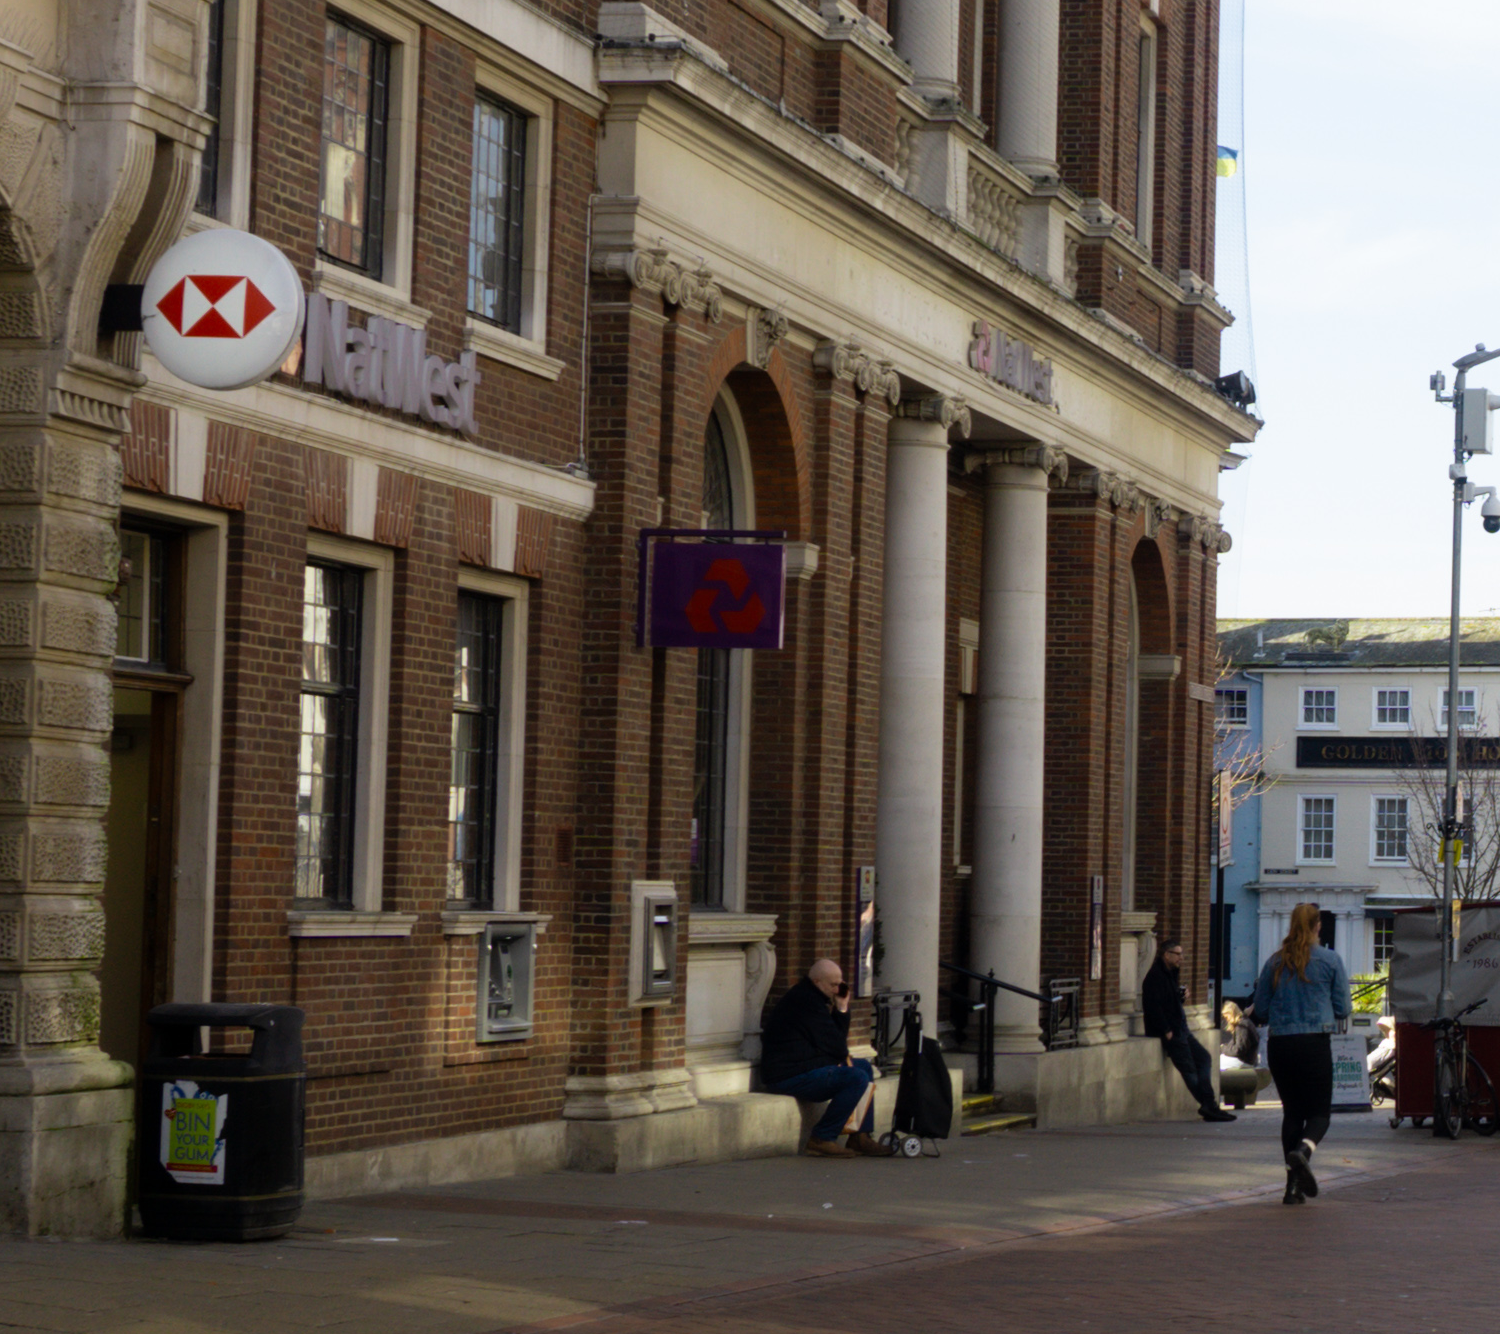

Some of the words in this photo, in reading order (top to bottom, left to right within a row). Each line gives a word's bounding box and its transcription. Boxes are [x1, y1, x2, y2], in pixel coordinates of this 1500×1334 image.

[304, 292, 481, 434] NatWest
[989, 327, 1053, 406] NatWest
[1321, 744, 1403, 762] GOLDEN
[1473, 957, 1499, 969] 1986
[175, 1111, 211, 1132] BIN
[175, 1133, 210, 1146] YOUR
[174, 1147, 209, 1161] GUM
